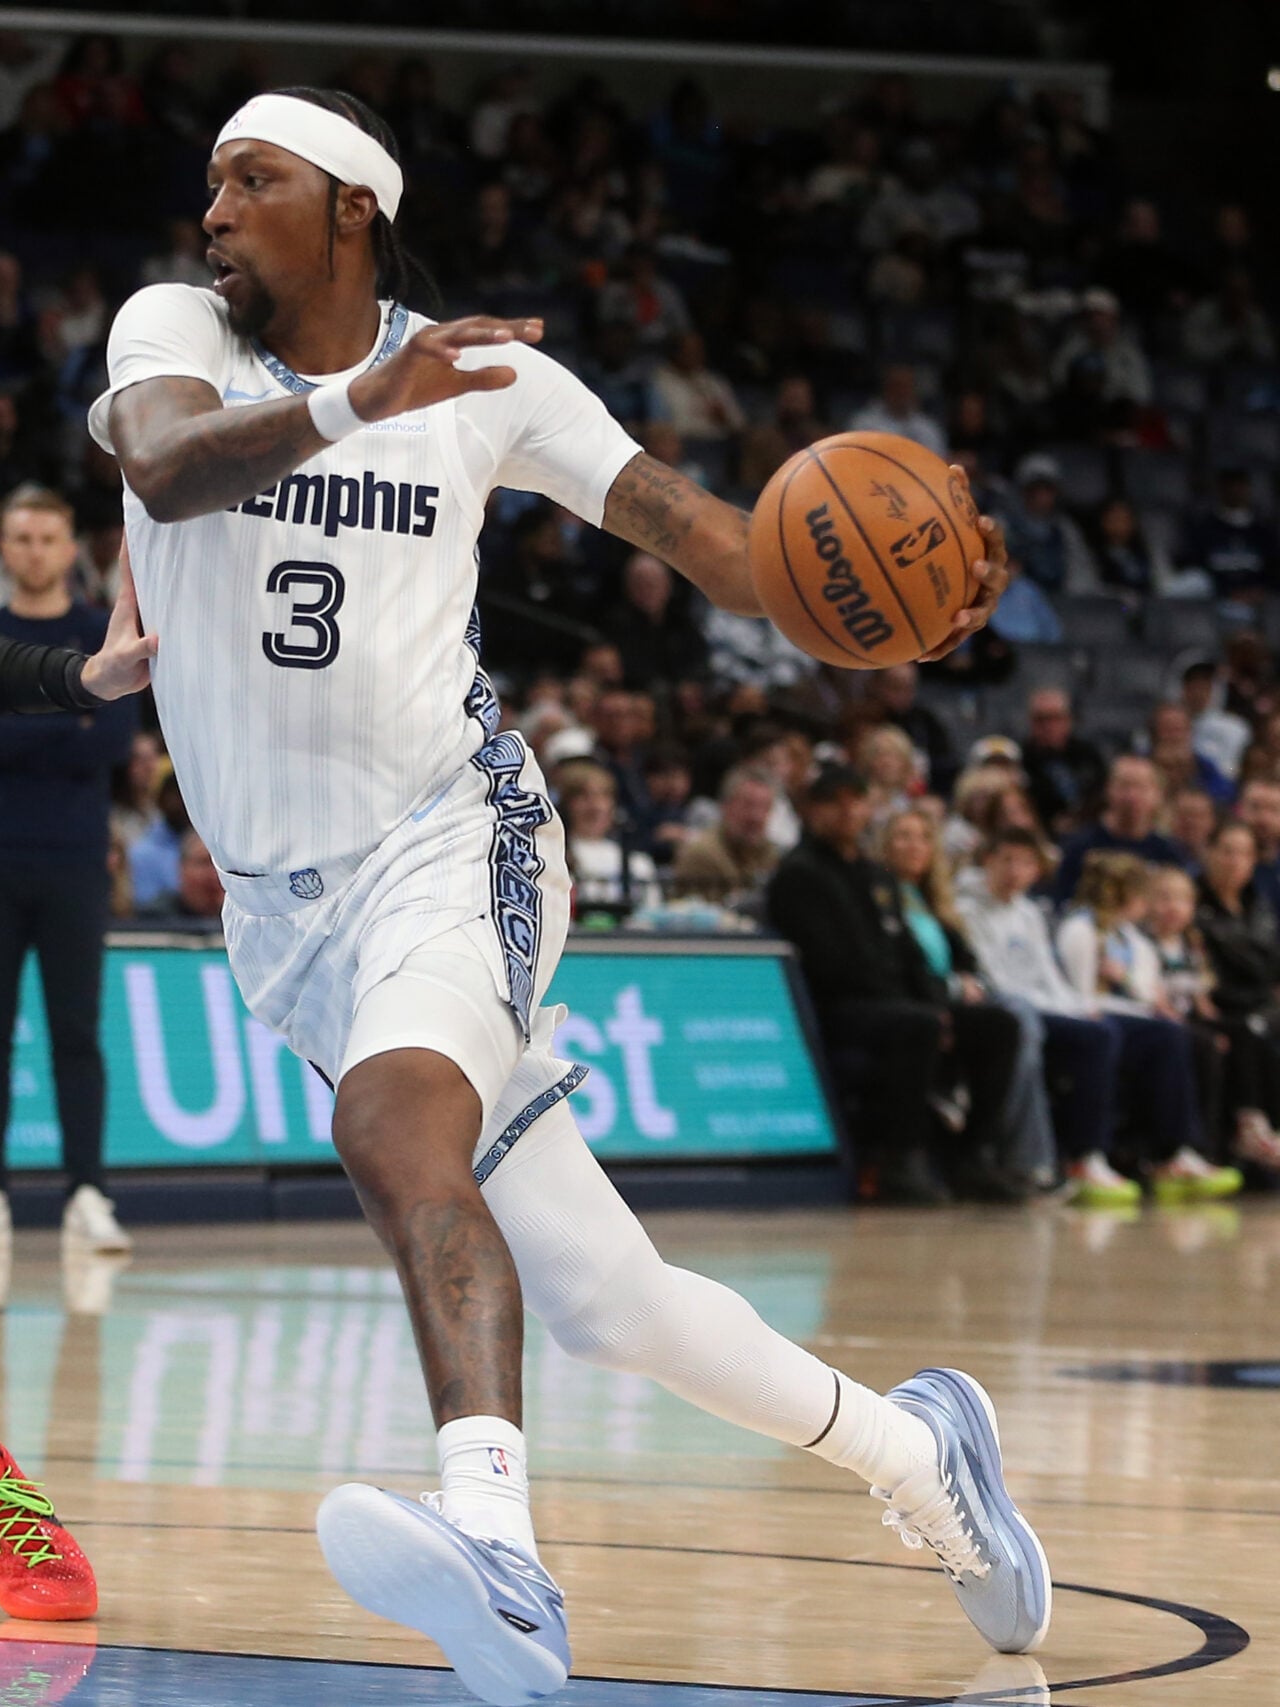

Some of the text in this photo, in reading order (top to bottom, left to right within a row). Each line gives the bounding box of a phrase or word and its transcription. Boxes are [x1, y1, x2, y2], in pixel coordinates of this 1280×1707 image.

[363, 420, 426, 433] obinhood
[226, 471, 439, 537] emphis
[262, 560, 345, 670] 3
[805, 502, 894, 650] Wilson
